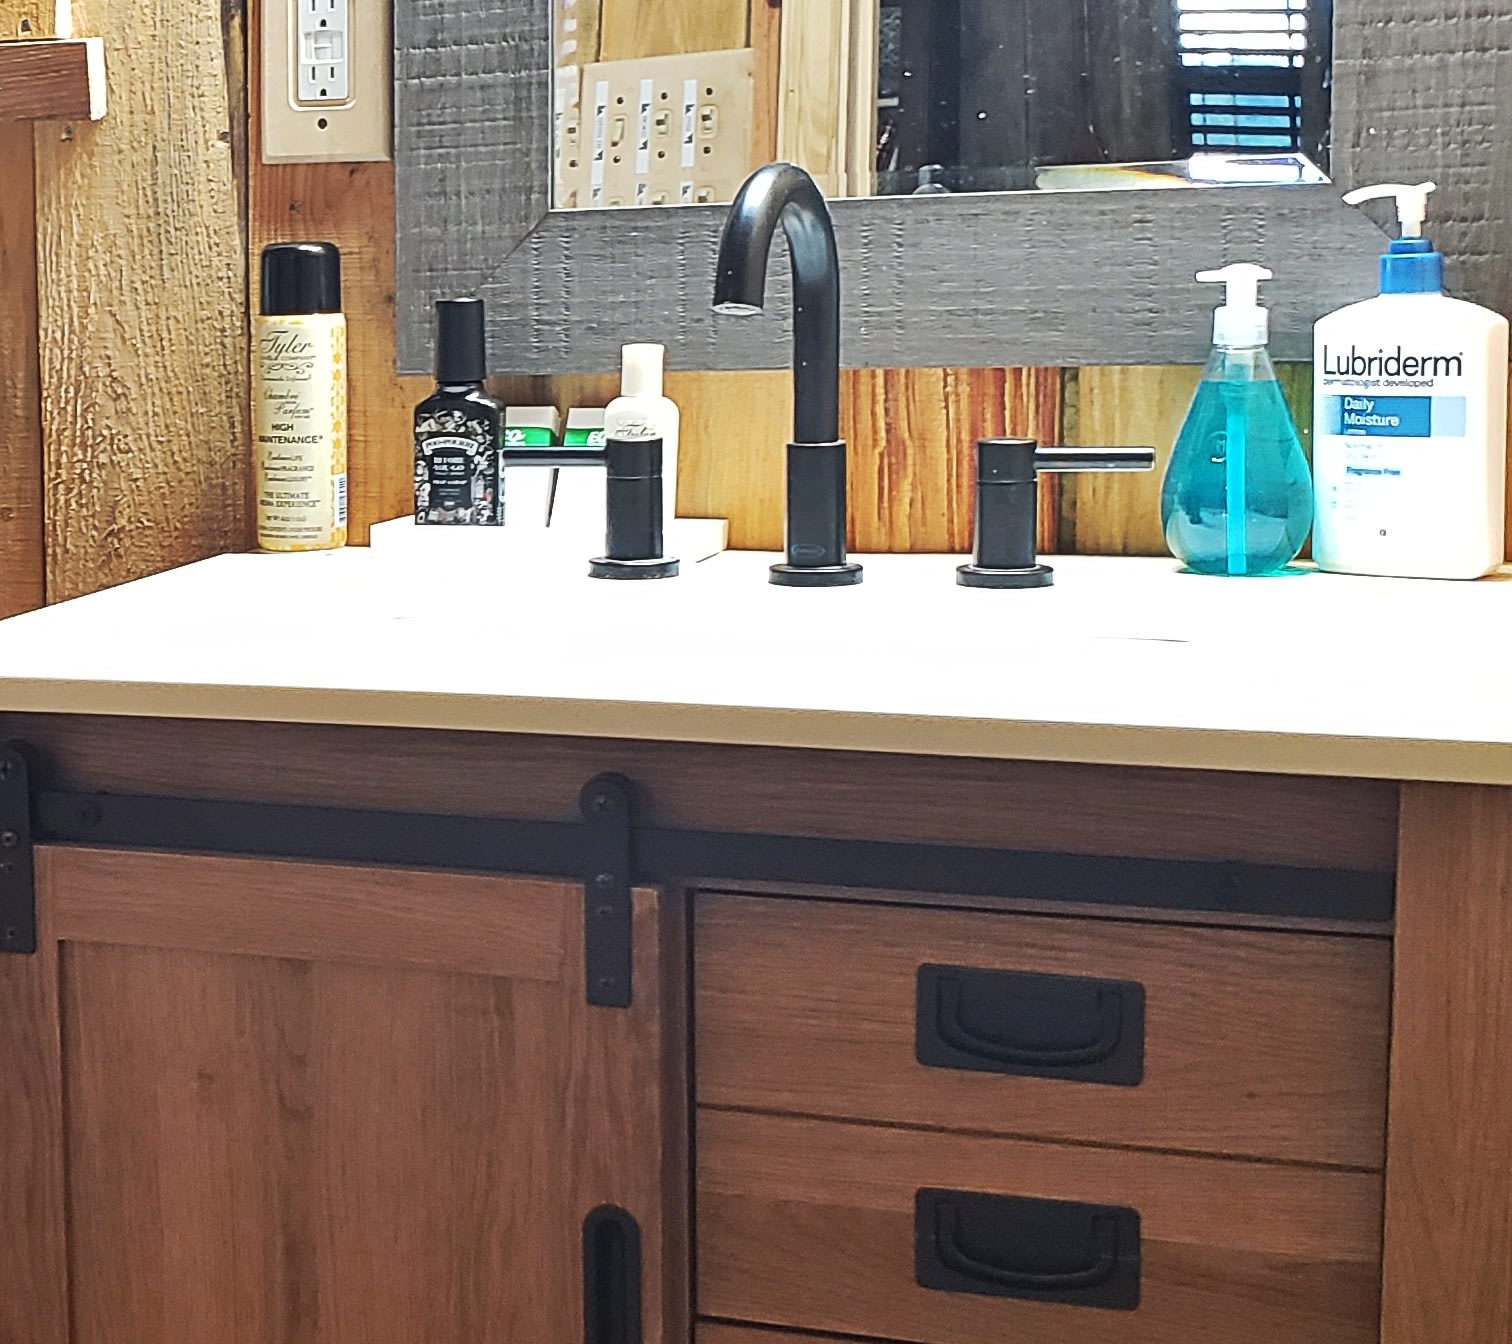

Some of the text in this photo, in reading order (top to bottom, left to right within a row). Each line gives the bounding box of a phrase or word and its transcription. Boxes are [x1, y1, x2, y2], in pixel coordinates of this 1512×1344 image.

[260, 330, 313, 361] Tyler
[1324, 345, 1462, 376] Lubriderm
[1383, 378, 1433, 388] developed
[1344, 397, 1374, 413] Daily
[1344, 413, 1400, 426] Moisture
[271, 423, 294, 431] HIGH
